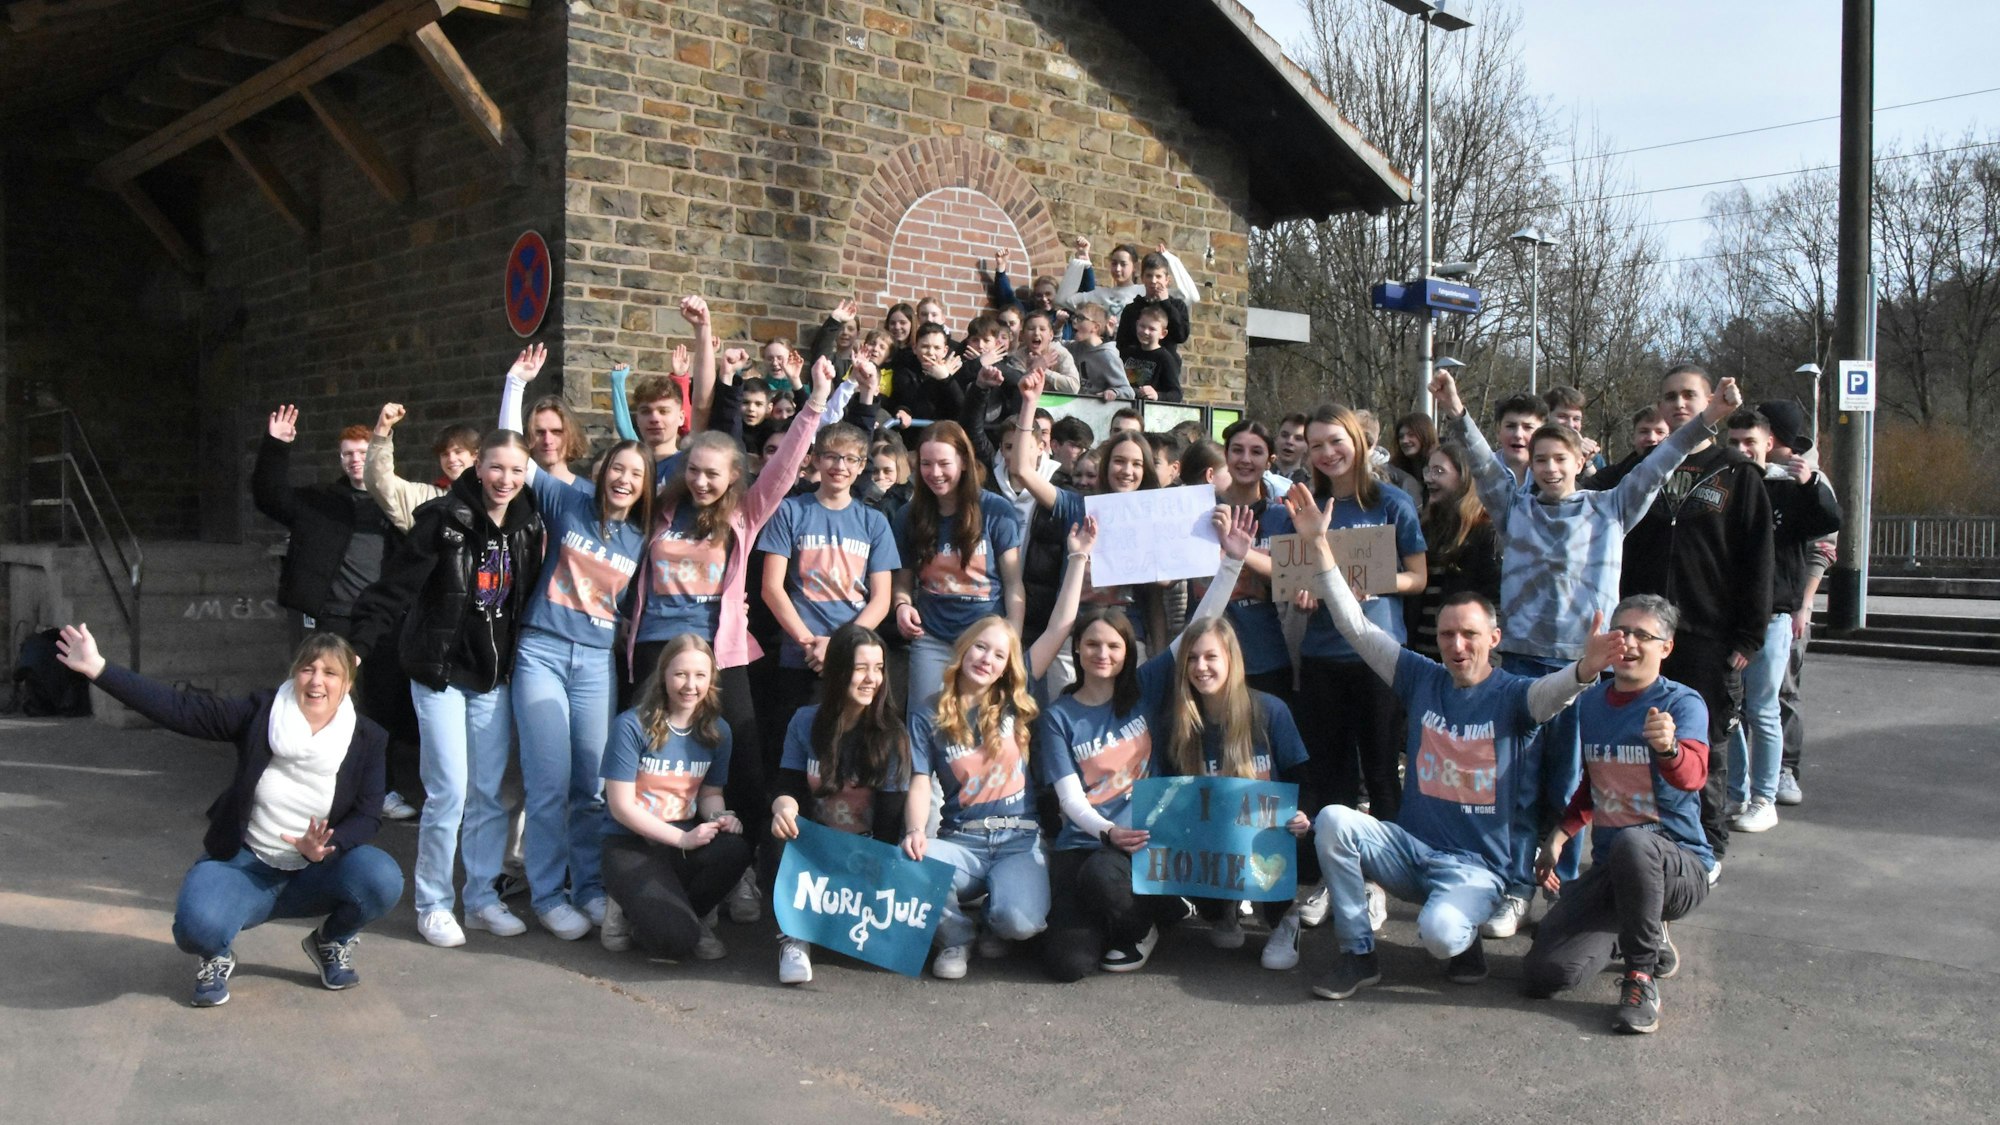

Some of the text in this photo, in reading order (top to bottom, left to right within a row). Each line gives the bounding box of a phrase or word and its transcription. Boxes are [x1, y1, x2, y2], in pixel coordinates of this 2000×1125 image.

[562, 530, 593, 556] JULE
[594, 546, 607, 562] &
[842, 537, 871, 560] NURI
[1278, 539, 1313, 568] JUL
[677, 558, 699, 583] &
[1106, 731, 1120, 748] &
[1120, 714, 1148, 742] NURI
[1449, 724, 1459, 742] &
[1463, 720, 1495, 742] NURI
[674, 760, 684, 777] &
[1603, 744, 1611, 763] &
[1616, 745, 1651, 765] NURI
[1440, 759, 1460, 787] &
[1234, 792, 1281, 829] AM
[1461, 805, 1496, 815] I'M HOME
[1147, 847, 1246, 892] HOME
[793, 870, 863, 917] NURI
[871, 888, 932, 930] JULE
